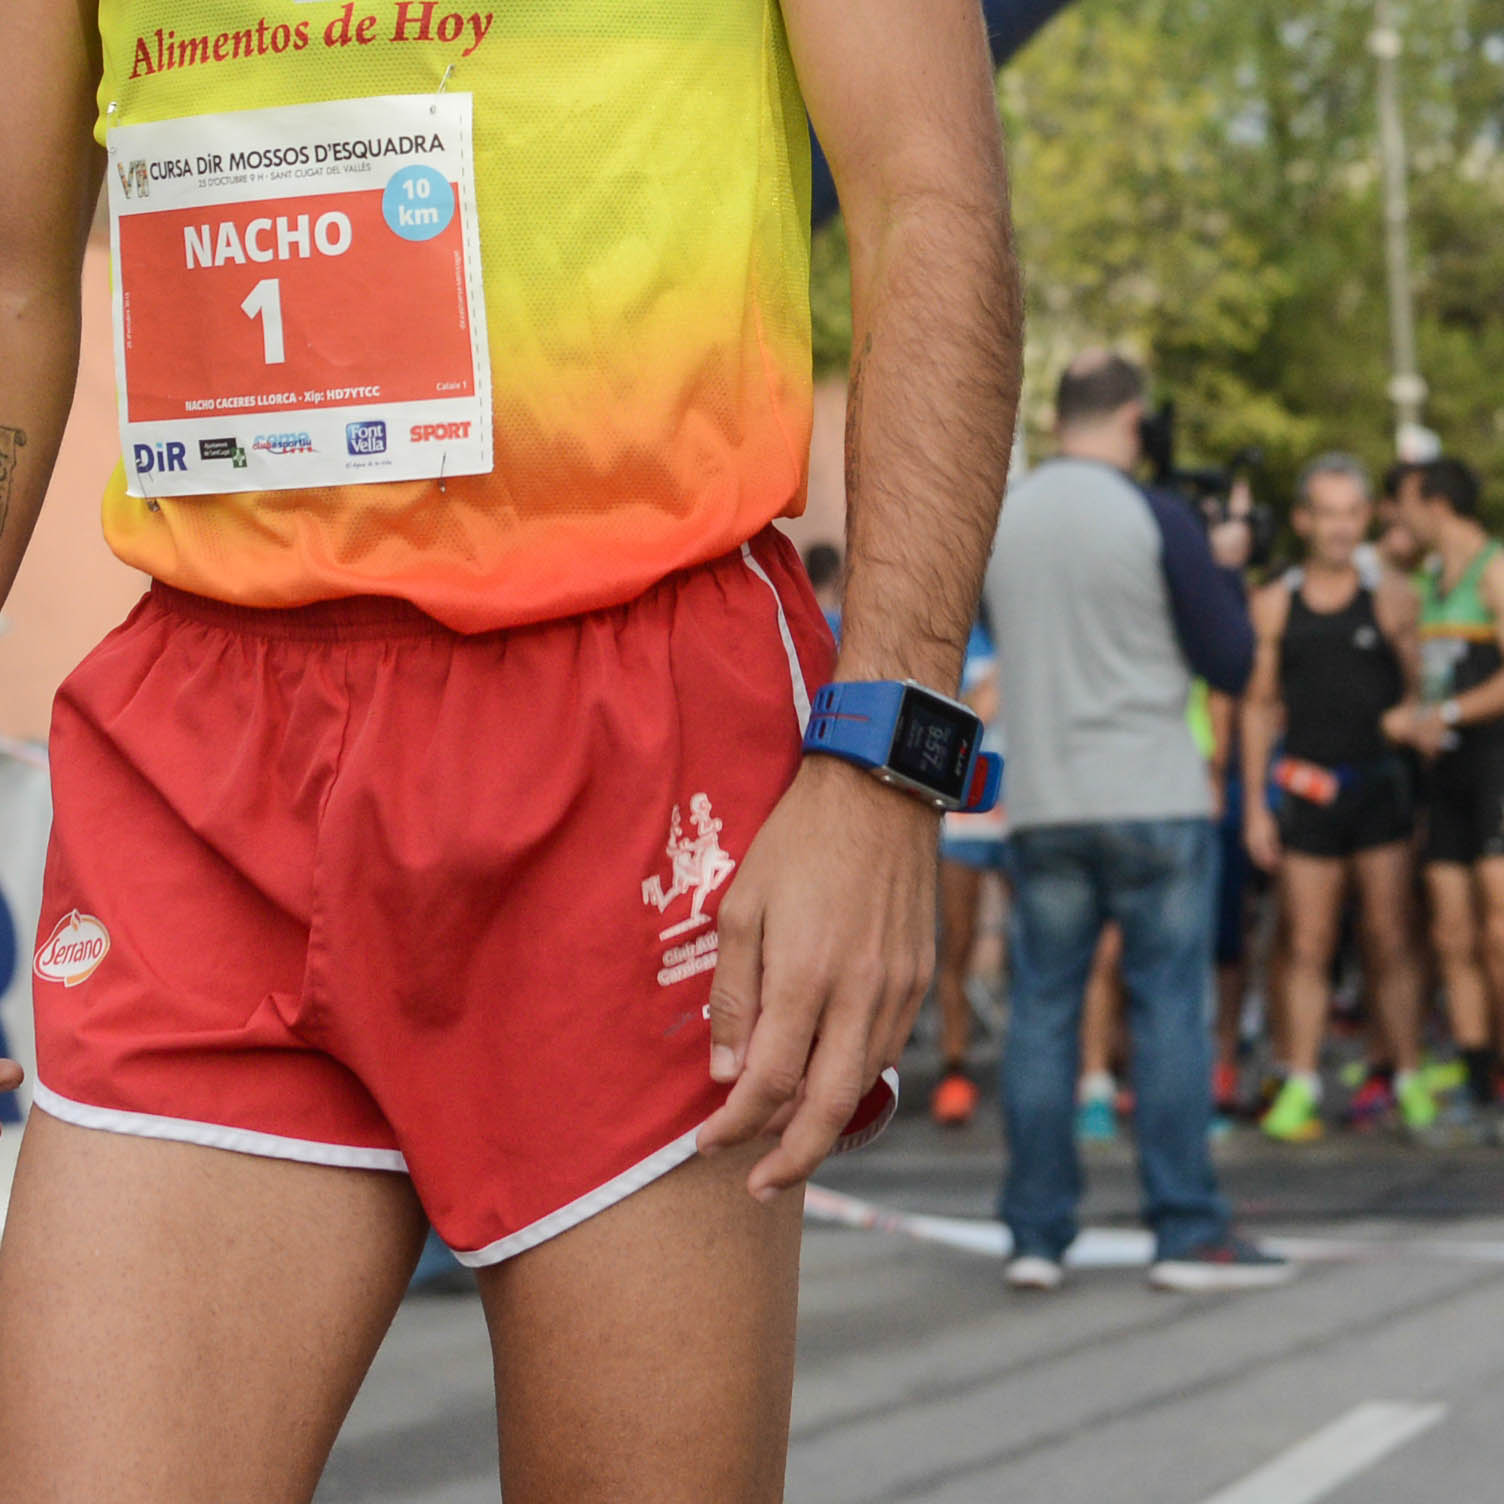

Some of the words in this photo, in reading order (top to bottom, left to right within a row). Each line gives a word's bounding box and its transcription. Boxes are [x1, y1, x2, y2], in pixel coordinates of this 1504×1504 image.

[129, 17, 310, 79] Alimentos
[323, 2, 377, 47] de
[388, 0, 494, 56] Hoy
[149, 159, 193, 181] CURSA
[196, 153, 223, 175] DiR
[229, 146, 309, 172] MOSSOS
[315, 133, 445, 163] D'ESQUADRA
[270, 170, 291, 181] SANT
[295, 167, 323, 178] CUGAT
[326, 165, 341, 175] DEL
[403, 178, 430, 200] 10
[399, 204, 439, 226] km
[184, 211, 352, 269] NACHO
[241, 278, 285, 364] 1
[185, 399, 215, 411] NACHO
[216, 395, 256, 409] CACERES
[257, 392, 296, 406] LLORCA
[351, 424, 384, 439] Font
[410, 421, 472, 442] SPORT
[352, 438, 384, 453] Vella
[133, 442, 188, 473] DiR
[42, 937, 103, 966] Serrano
